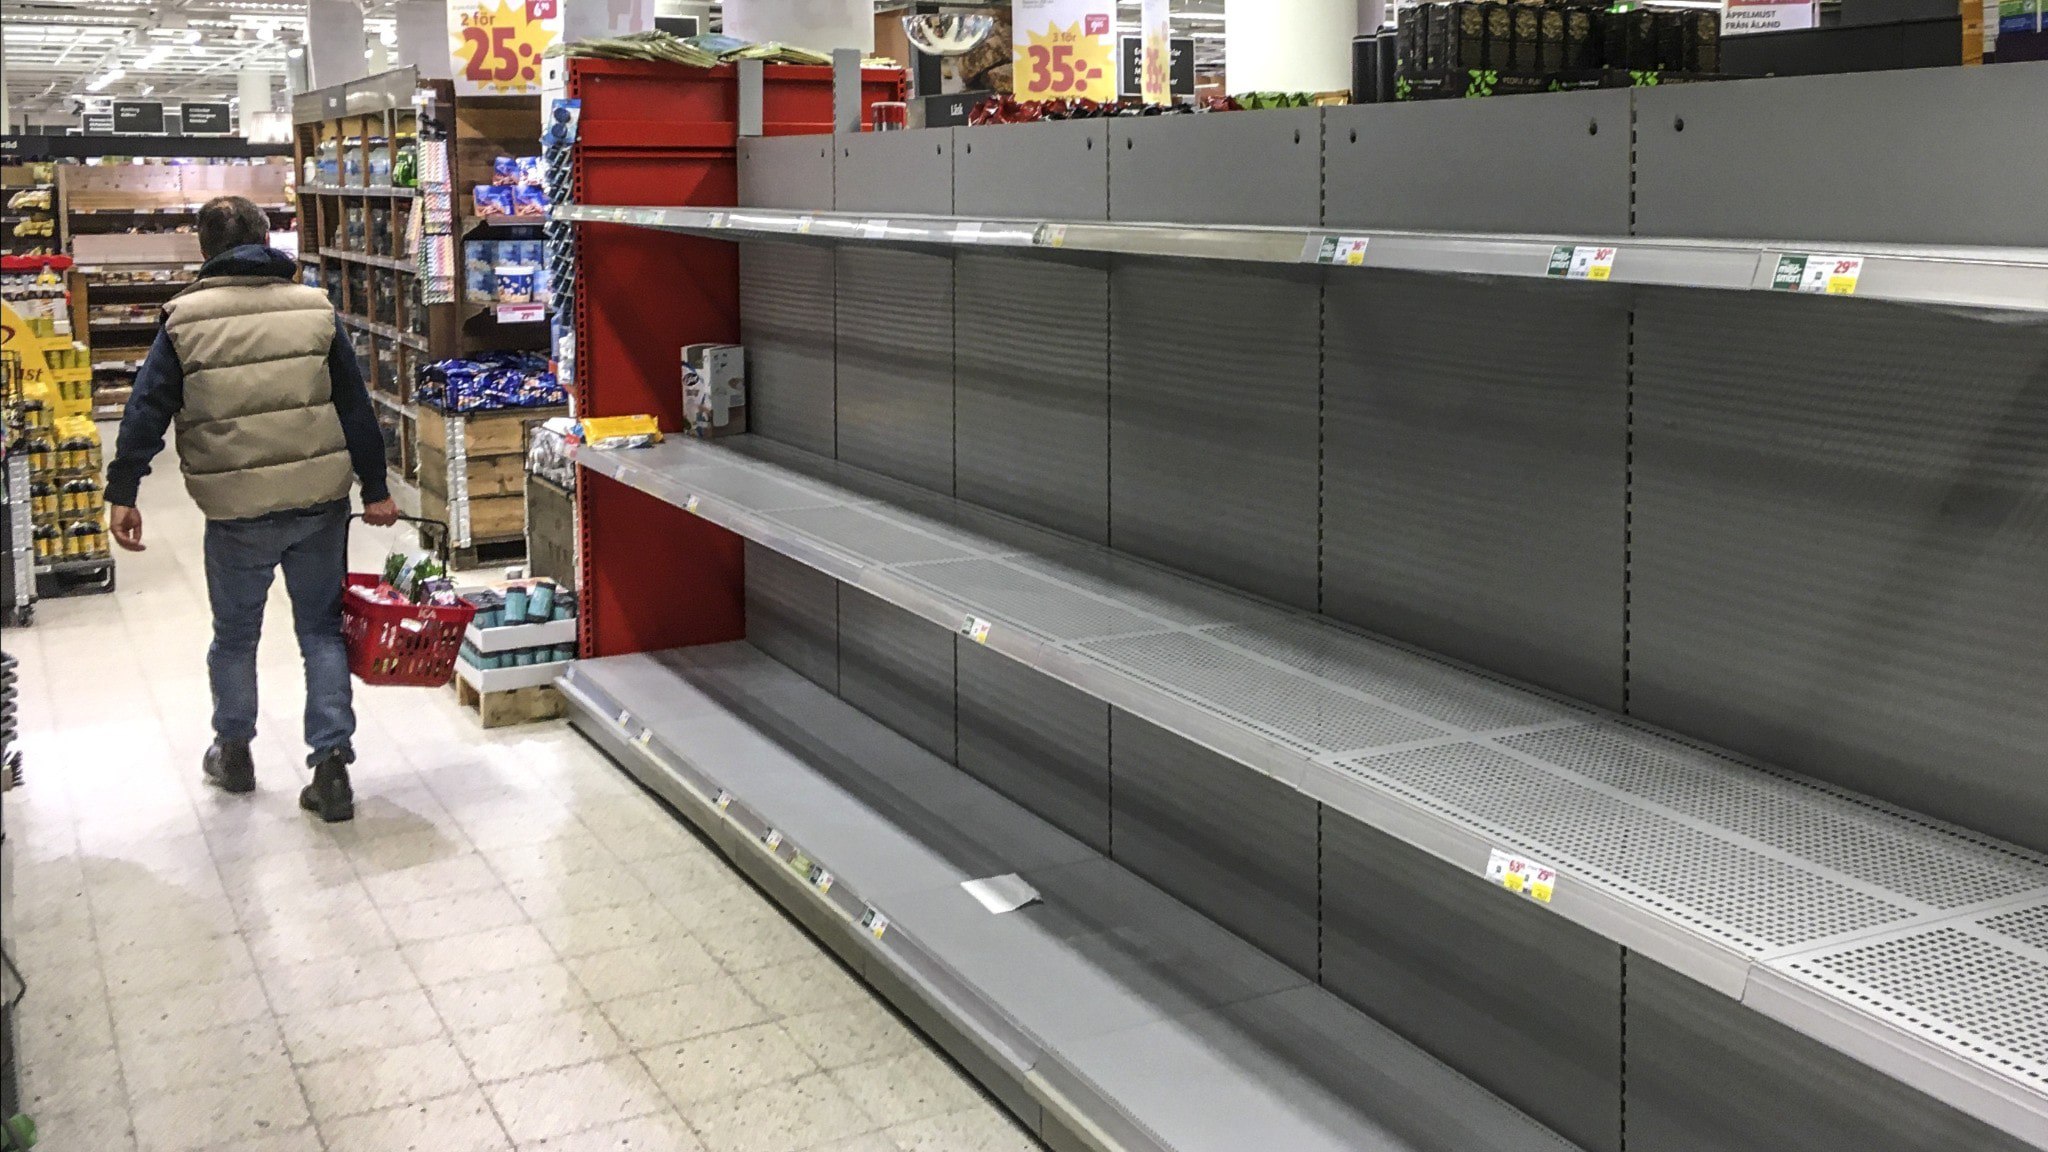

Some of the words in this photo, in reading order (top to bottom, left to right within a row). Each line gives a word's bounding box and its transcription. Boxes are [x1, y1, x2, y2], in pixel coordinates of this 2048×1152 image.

[461, 13, 469, 26] 2
[473, 11, 495, 26] för
[1750, 20, 1780, 28] ÅLAND
[1053, 33, 1059, 42] 3
[1061, 32, 1076, 42] för
[1028, 45, 1102, 93] 35:-
